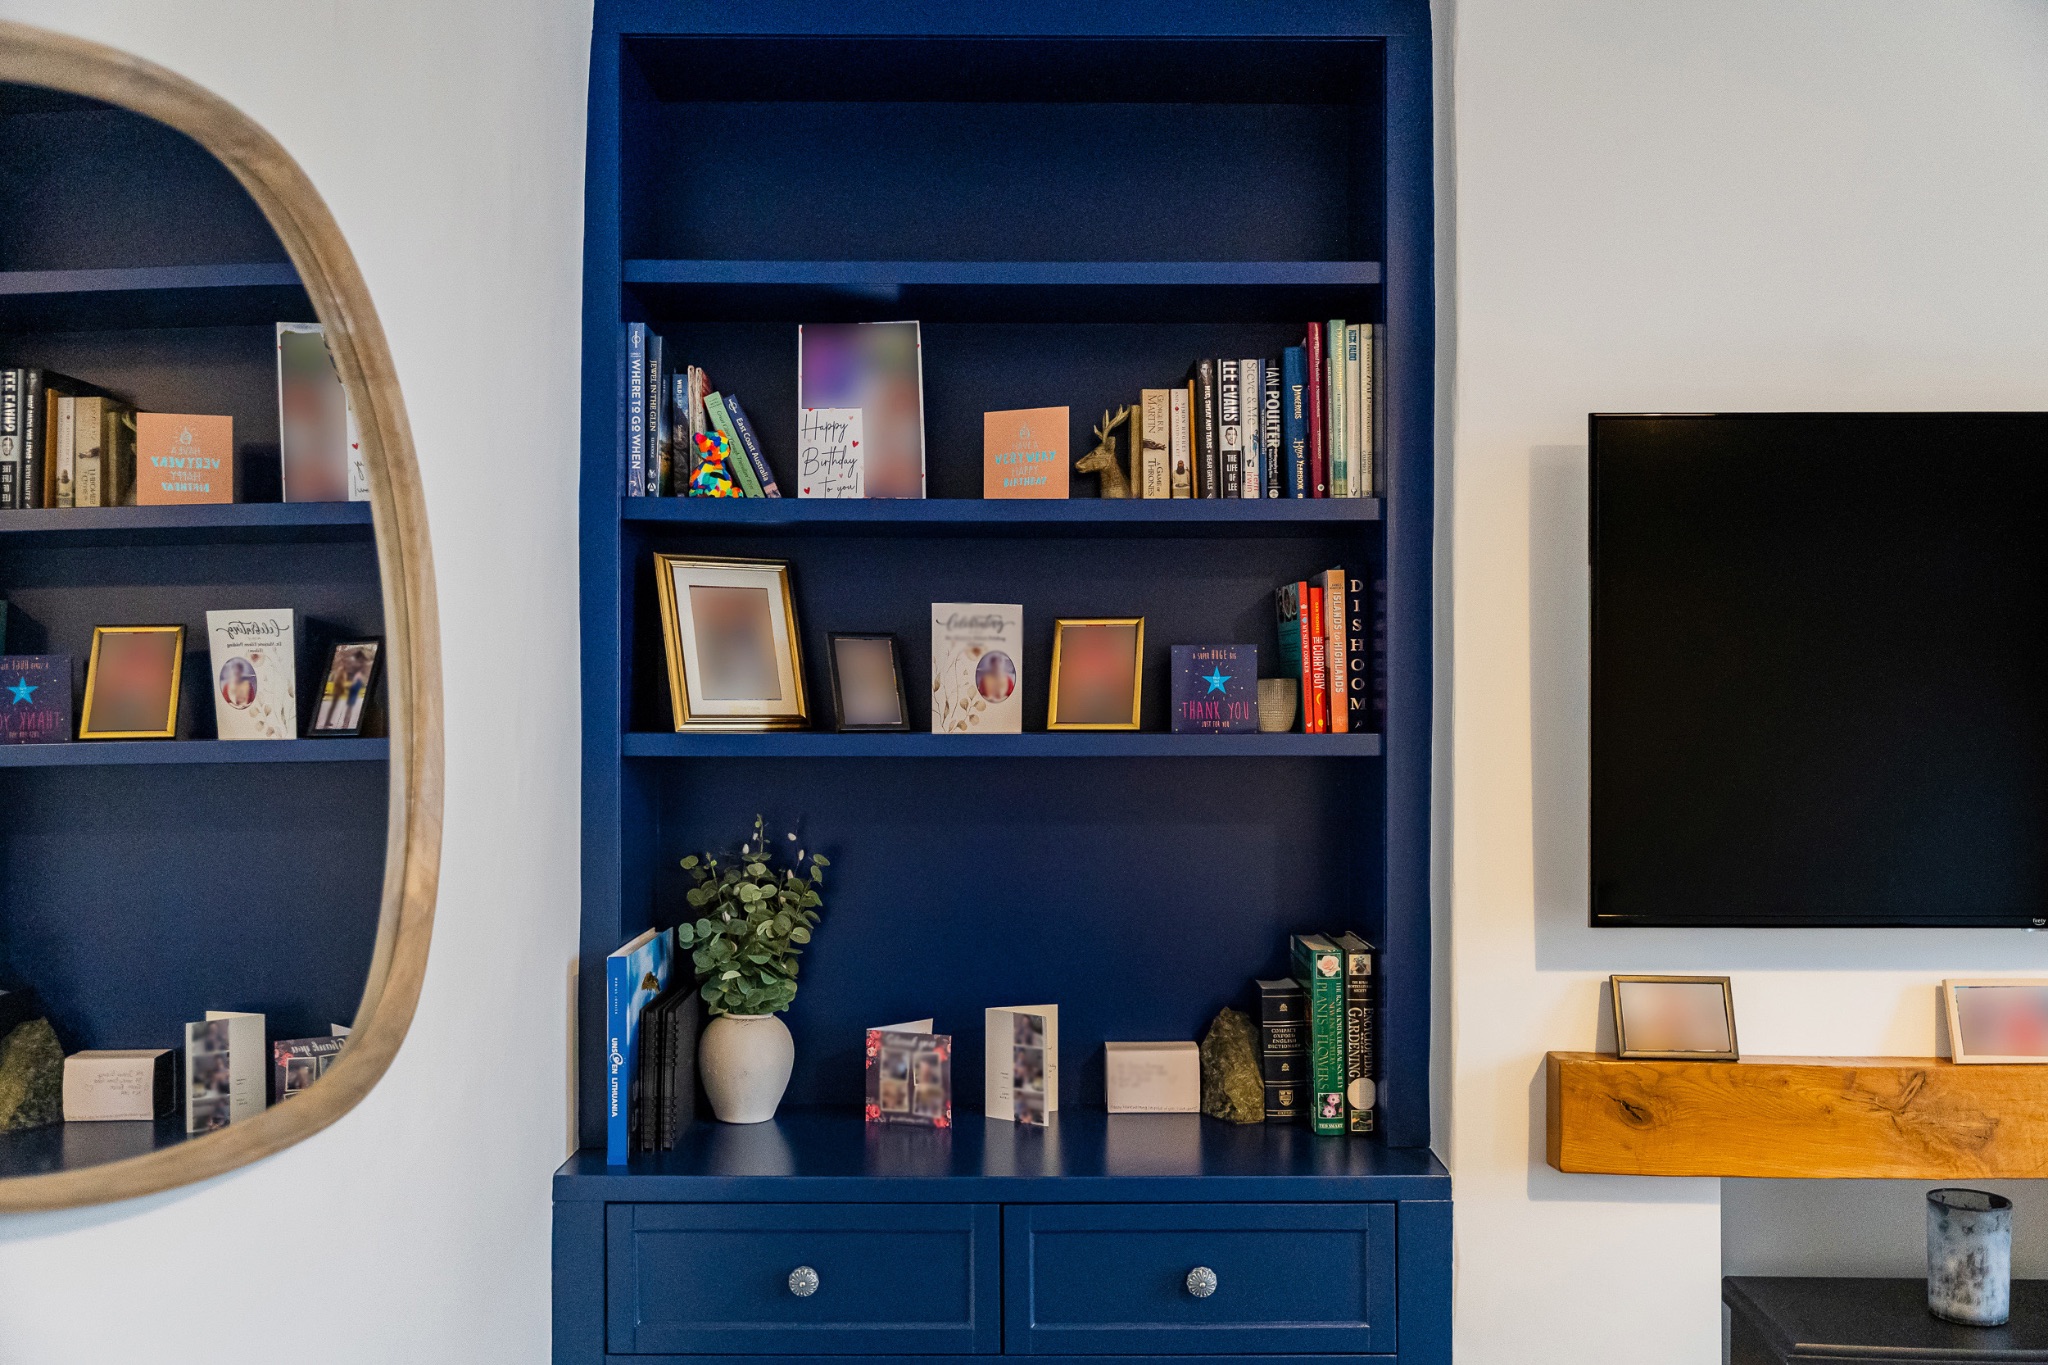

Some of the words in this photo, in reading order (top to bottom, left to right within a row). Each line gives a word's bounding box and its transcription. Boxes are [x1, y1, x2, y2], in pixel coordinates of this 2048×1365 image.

[632, 359, 640, 398] WHERE
[1223, 361, 1240, 381] LEE
[1246, 362, 1257, 394] Steve
[1266, 367, 1280, 386] IAN
[650, 384, 657, 394] IN
[1223, 384, 1240, 421] EVANS
[1247, 397, 1256, 405] &
[1292, 385, 1302, 420] DANGEROUS
[632, 401, 640, 413] TO
[1148, 395, 1157, 433] MARTIN
[1247, 407, 1257, 425] Me
[1266, 391, 1280, 448] POULTER
[632, 416, 640, 432] GO
[801, 411, 848, 443] Happy
[632, 435, 640, 469] WHEN
[736, 417, 746, 432] East
[743, 432, 755, 451] Coast
[752, 452, 769, 481] Australia
[802, 445, 858, 478] Birthday
[1148, 458, 1156, 496] THRONES
[1228, 483, 1237, 491] LEE
[1333, 592, 1342, 630] ISLANDS
[1334, 632, 1341, 640] to
[1350, 580, 1365, 710] DISHOOM
[1211, 650, 1227, 659] HUGE
[1313, 645, 1324, 671] CURRY
[1334, 641, 1344, 693] HIGHLANDS
[1314, 672, 1325, 689] GUY
[1182, 701, 1220, 719] THANK
[1228, 701, 1249, 719] YOU
[1316, 982, 1328, 1026] PLANTS
[1348, 1007, 1363, 1078] GARDENING
[1363, 1007, 1374, 1077] ENCYCLOPEDIA
[1317, 1034, 1329, 1090] FLOWERS
